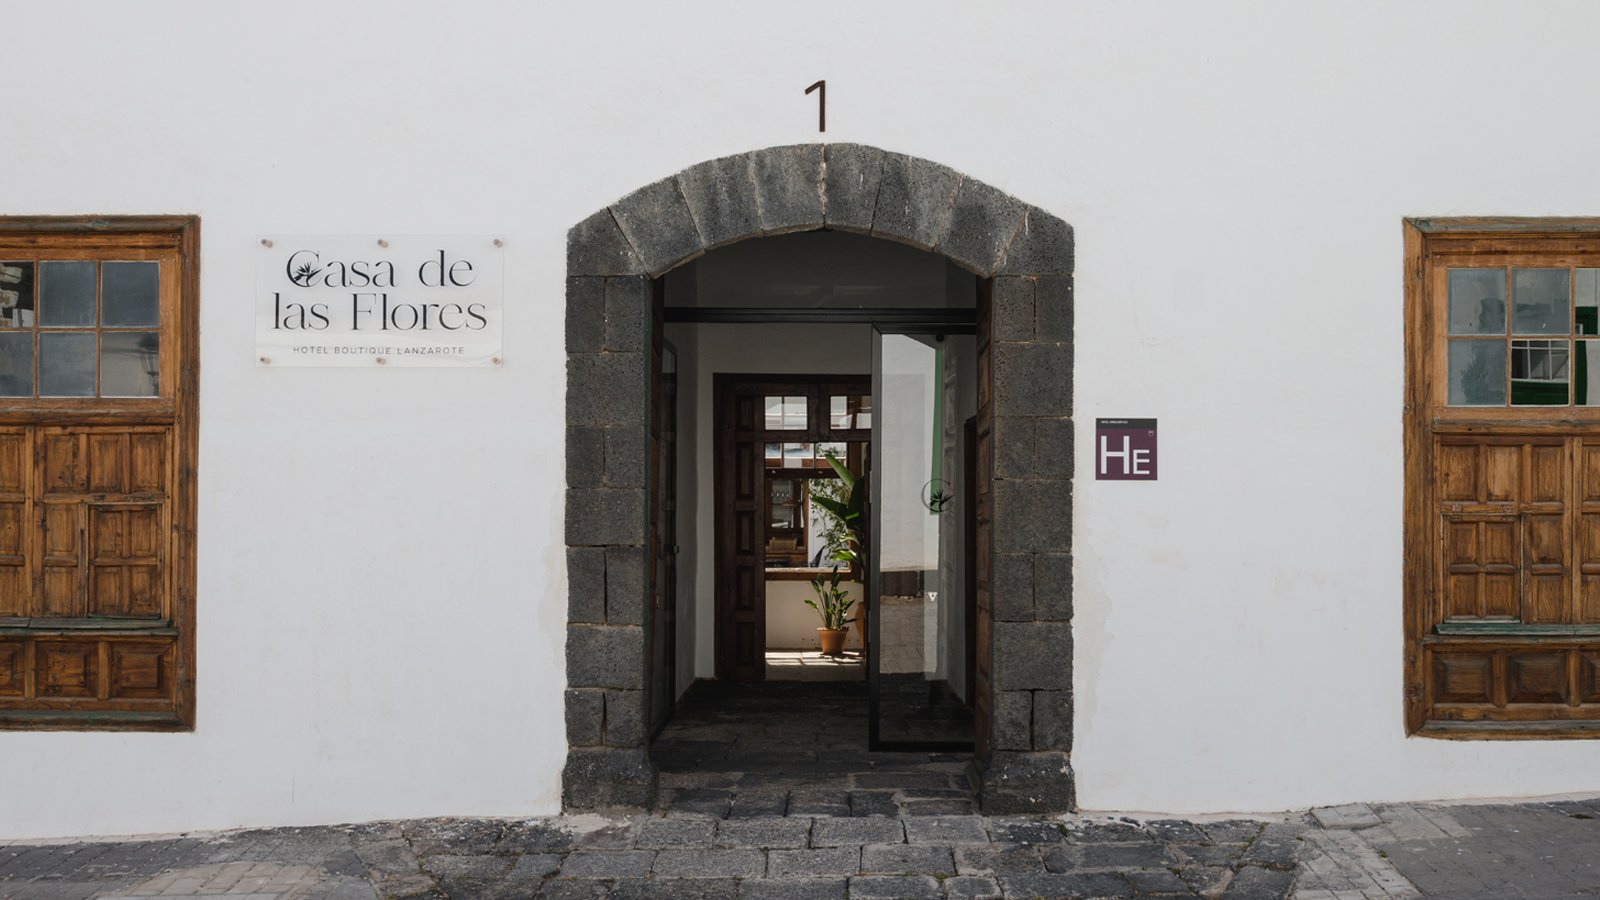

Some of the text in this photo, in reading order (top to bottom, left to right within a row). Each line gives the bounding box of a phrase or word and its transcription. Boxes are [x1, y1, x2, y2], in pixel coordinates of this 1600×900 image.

[805, 80, 826, 132] 1
[286, 249, 477, 288] Casa de
[272, 292, 488, 331] las Flores
[293, 346, 465, 355] HOTEL BOUTIQUE LANZAROTE
